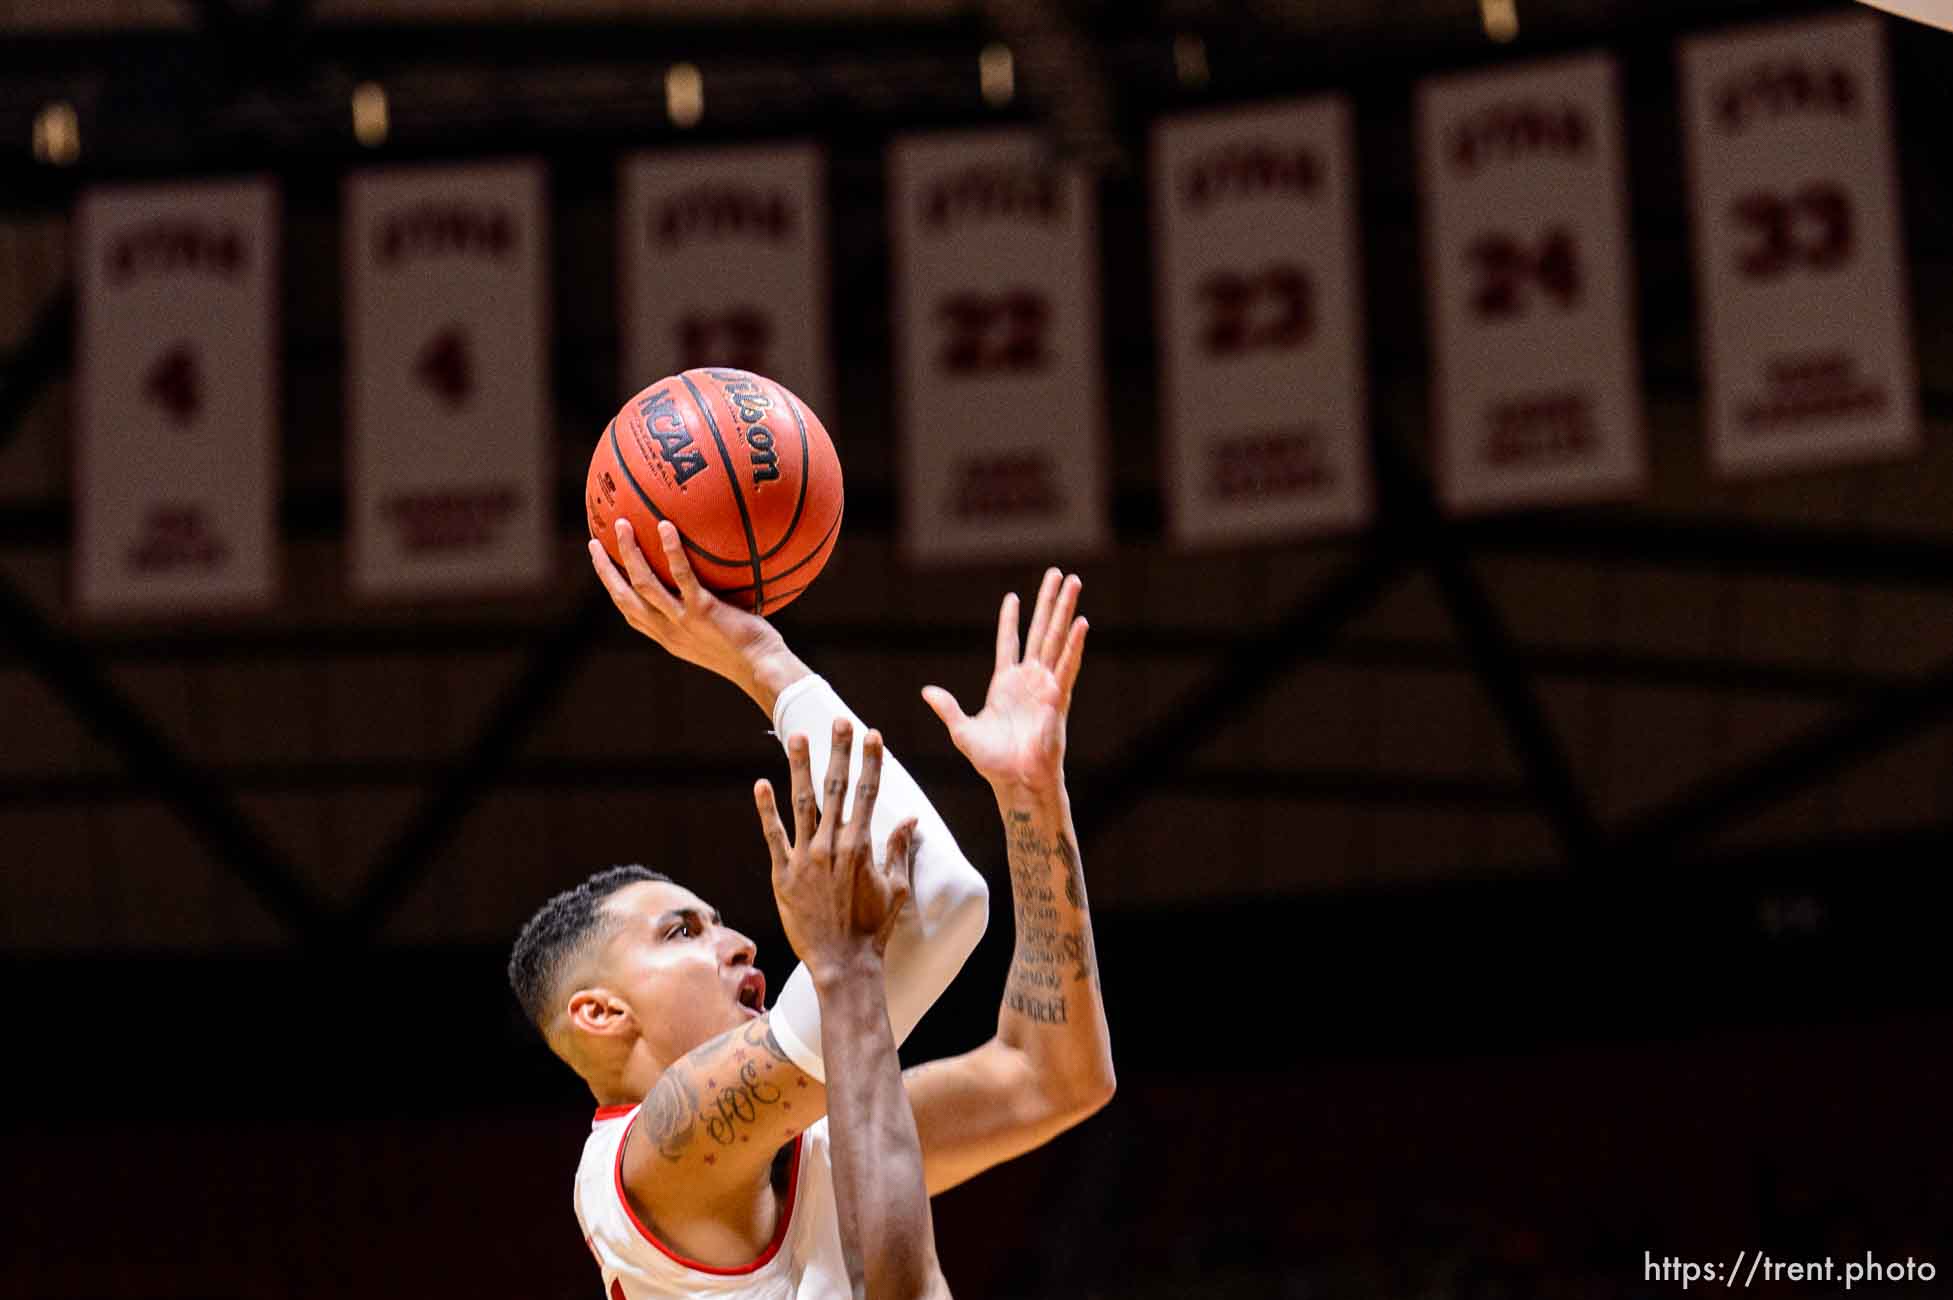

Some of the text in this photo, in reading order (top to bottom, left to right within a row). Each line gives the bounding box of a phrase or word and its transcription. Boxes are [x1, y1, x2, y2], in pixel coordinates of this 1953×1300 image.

[1466, 230, 1584, 318] 24
[1730, 184, 1858, 280] 33
[938, 292, 1050, 374] 22
[1200, 266, 1316, 356] 23
[148, 346, 201, 422] 4
[418, 325, 471, 404] 4
[638, 388, 708, 486] NCAA
